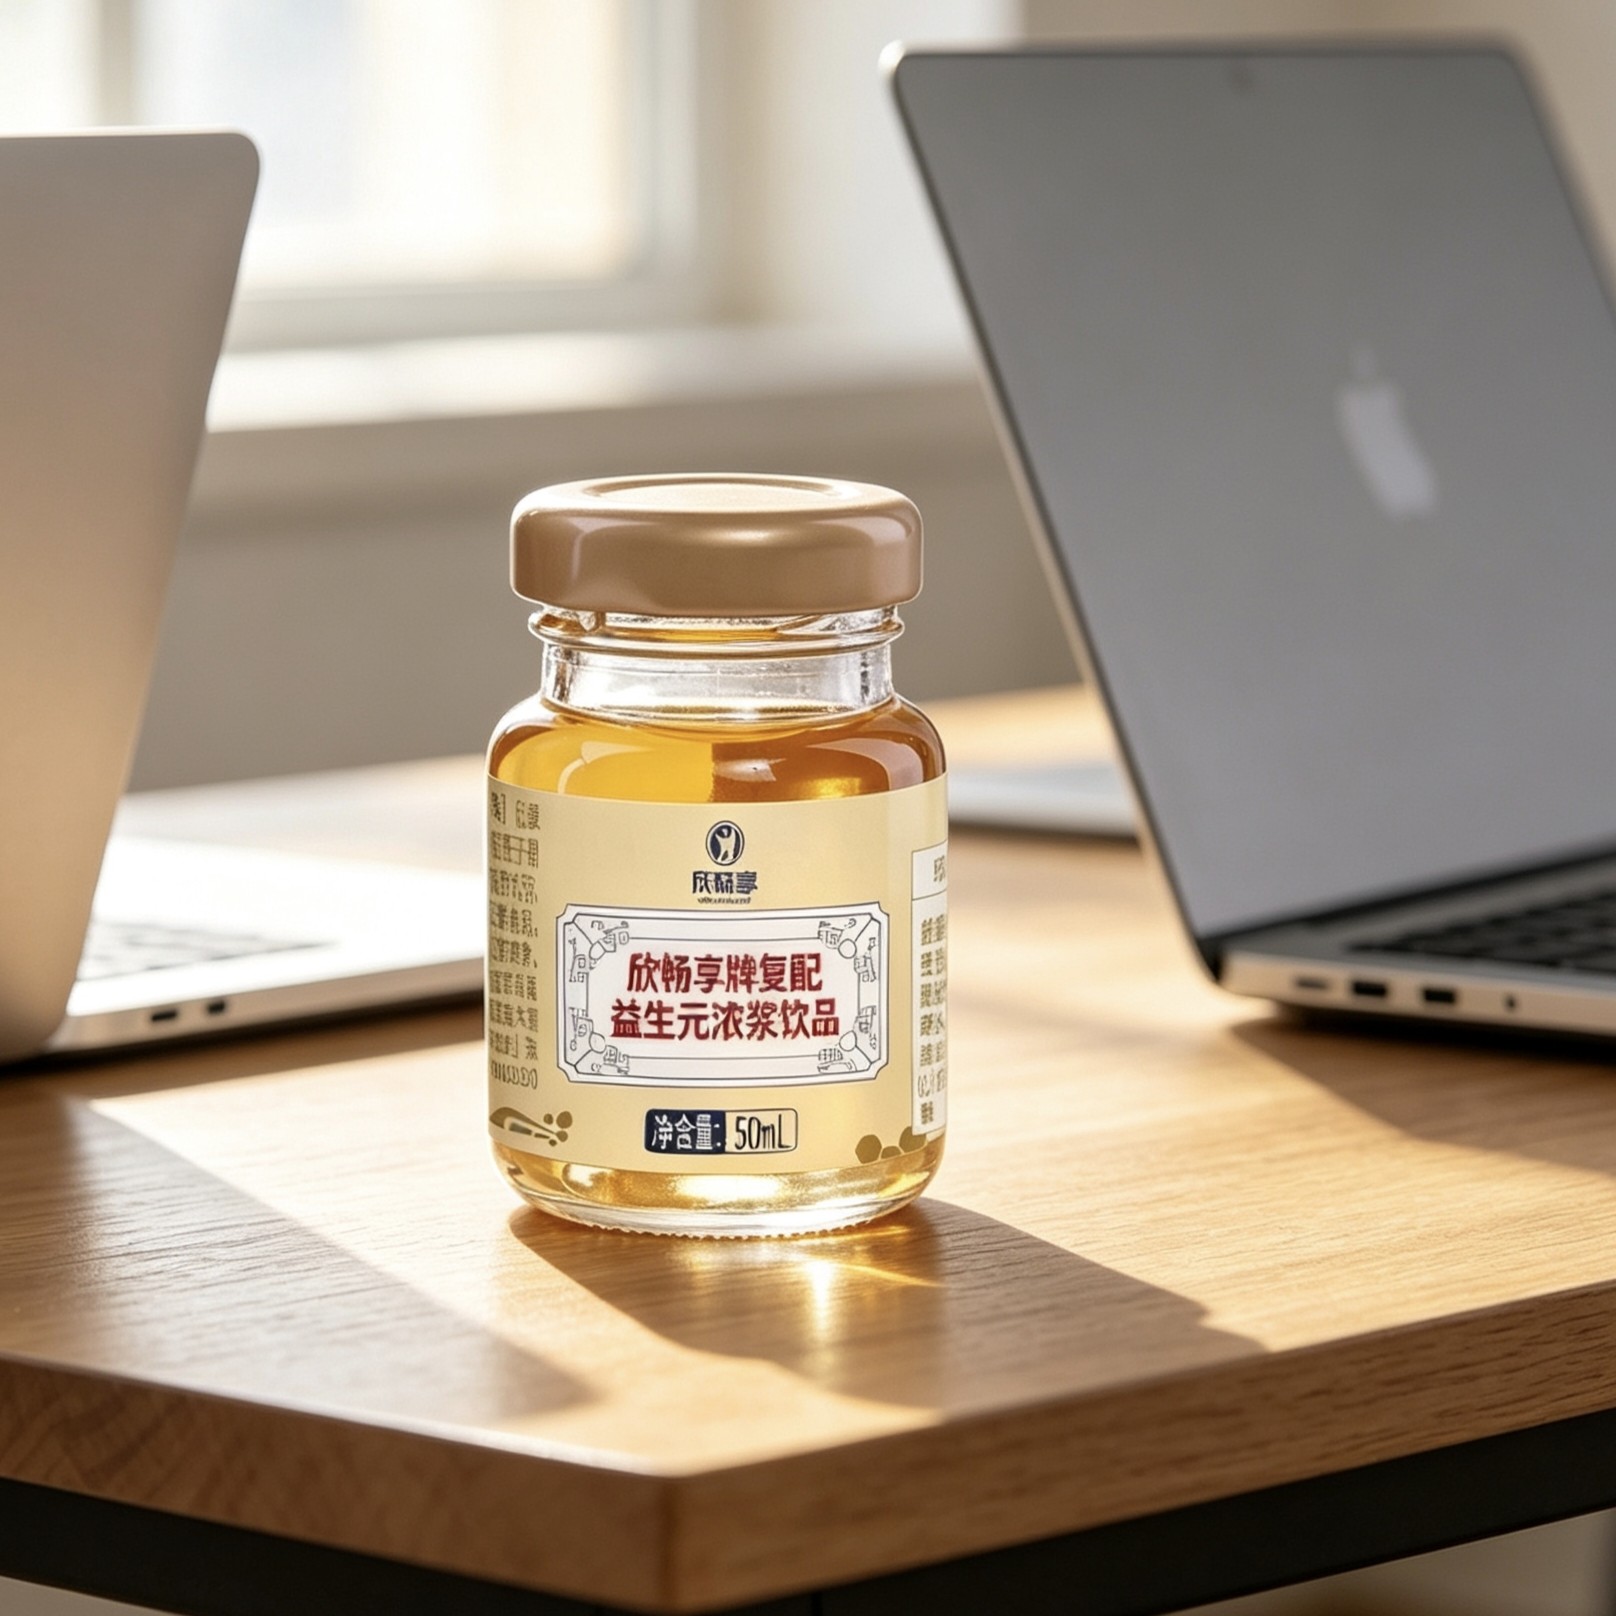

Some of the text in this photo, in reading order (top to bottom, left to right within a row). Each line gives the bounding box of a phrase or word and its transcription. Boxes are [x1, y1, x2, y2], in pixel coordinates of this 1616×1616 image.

[627, 951, 823, 993] 欣畅享牌复配
[610, 998, 839, 1041] 益生元浓浆饮品
[734, 1113, 793, 1150] 50mL
